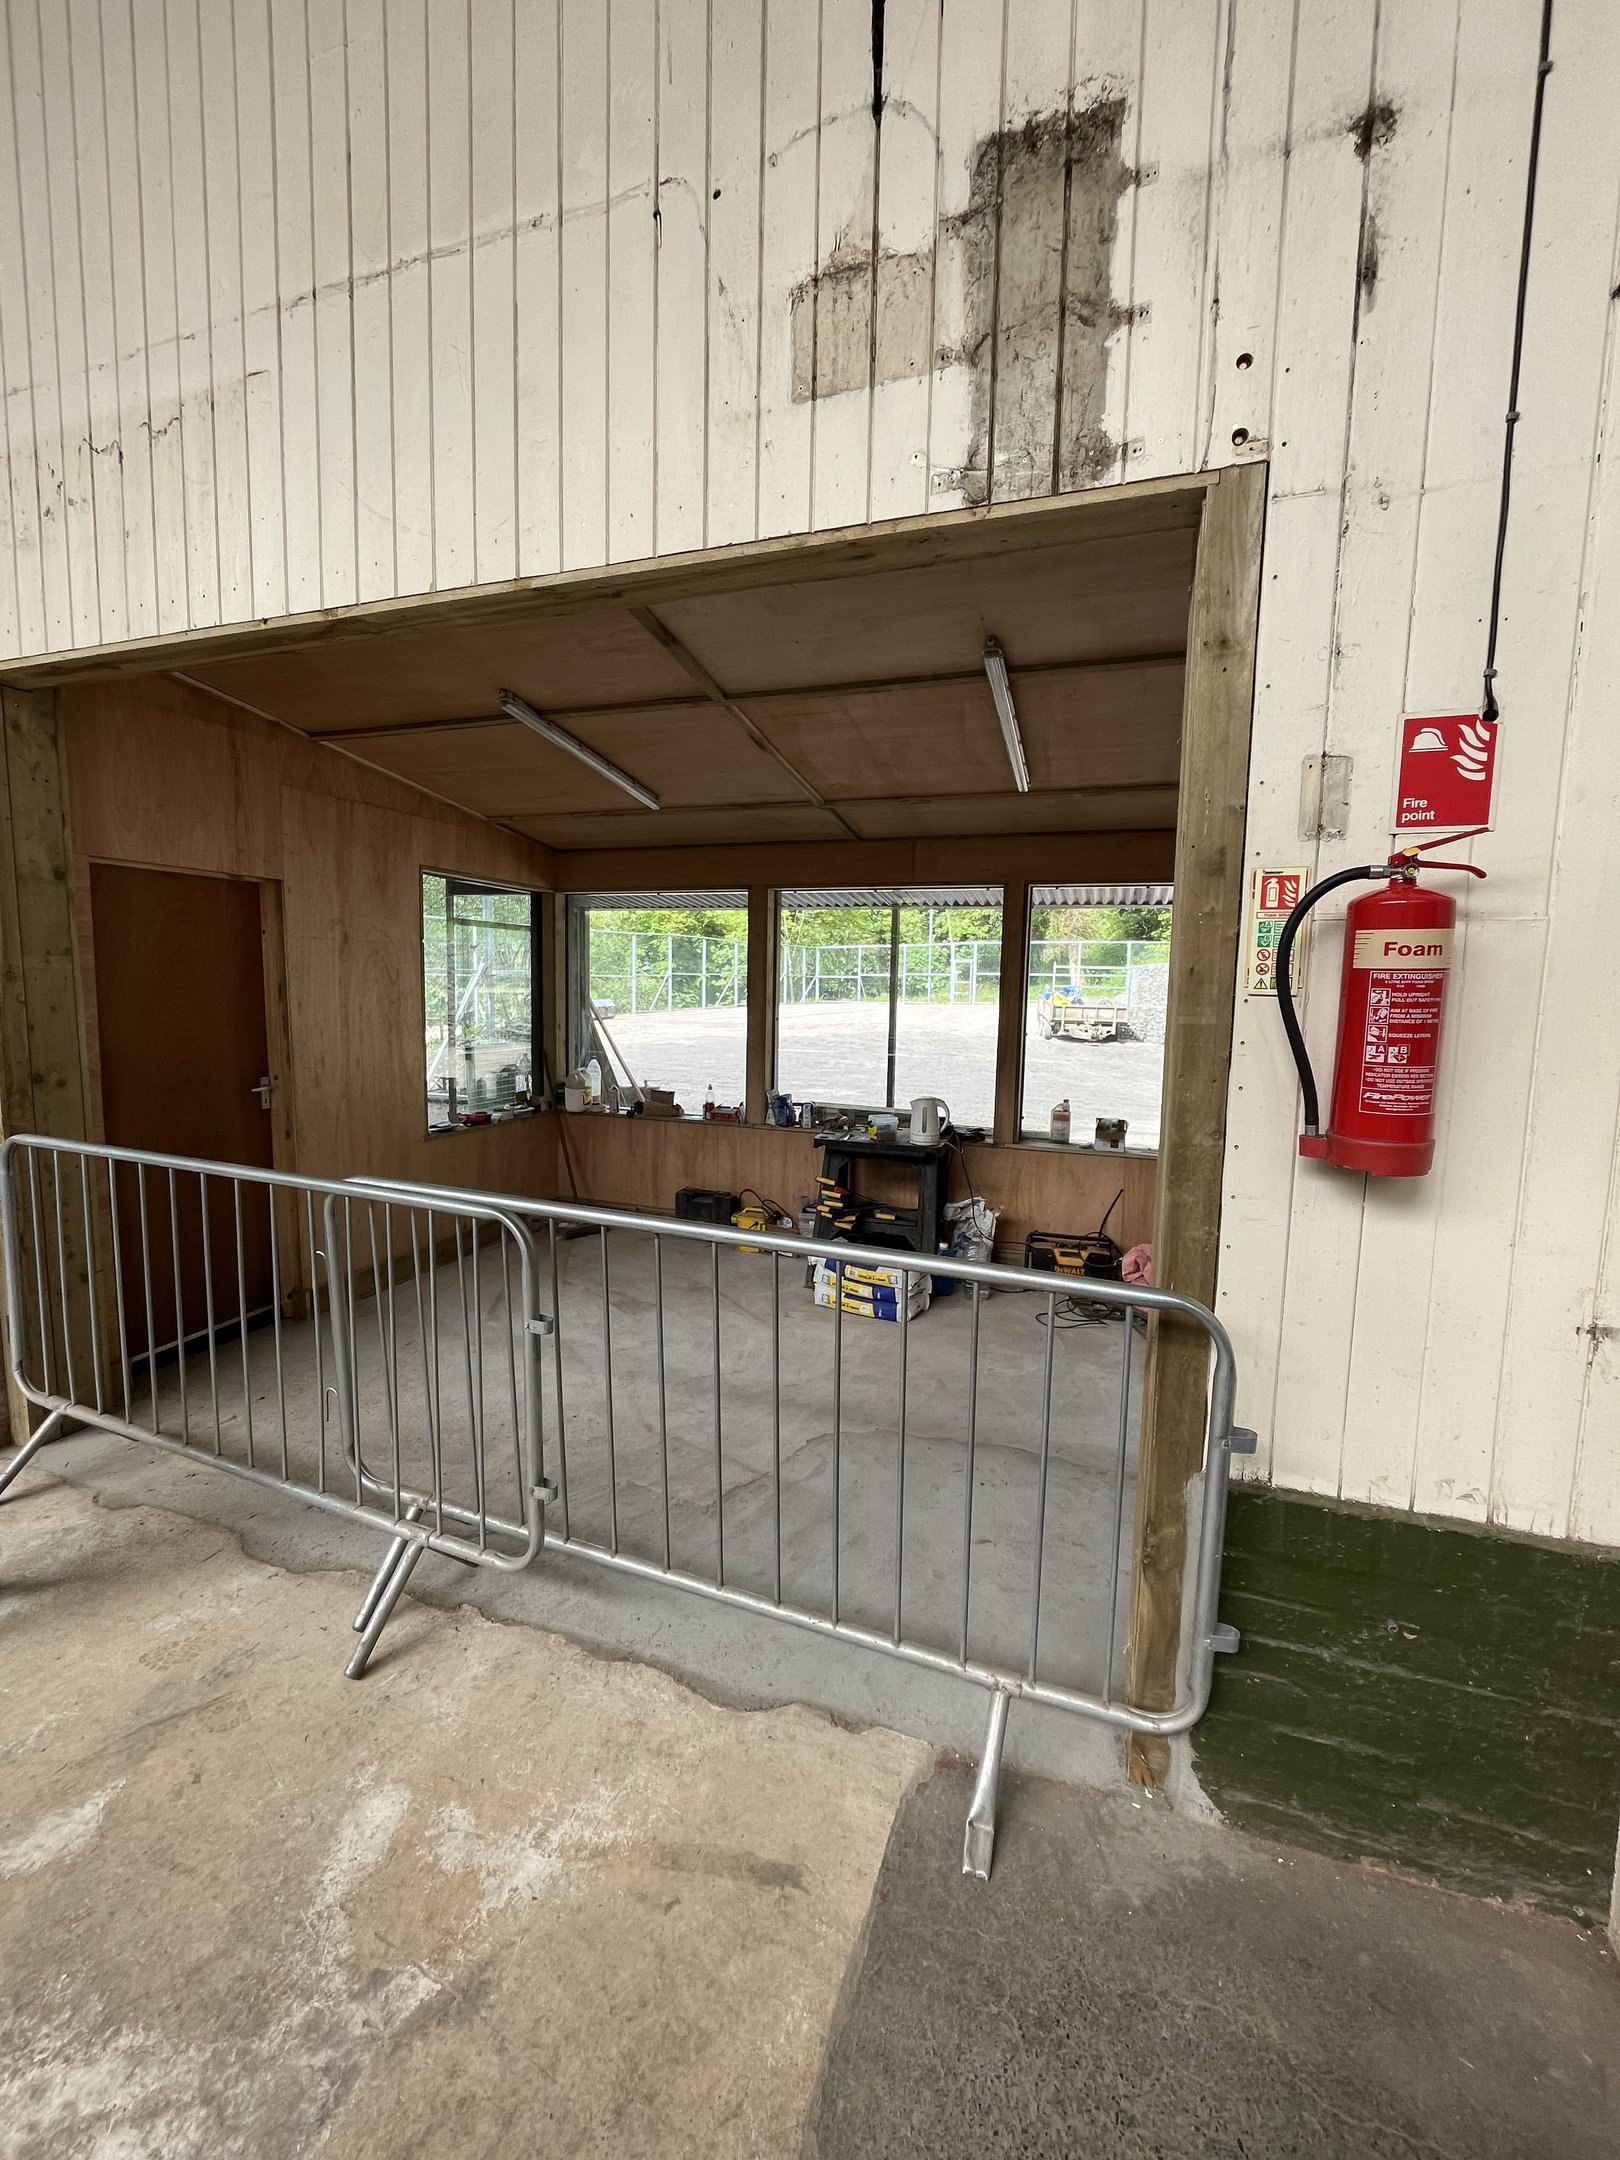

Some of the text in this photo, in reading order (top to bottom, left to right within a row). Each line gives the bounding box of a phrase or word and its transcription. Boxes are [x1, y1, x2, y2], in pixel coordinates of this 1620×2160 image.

[1402, 798, 1428, 808] Fire
[1401, 810, 1435, 823] point
[1383, 941, 1443, 957] Foam
